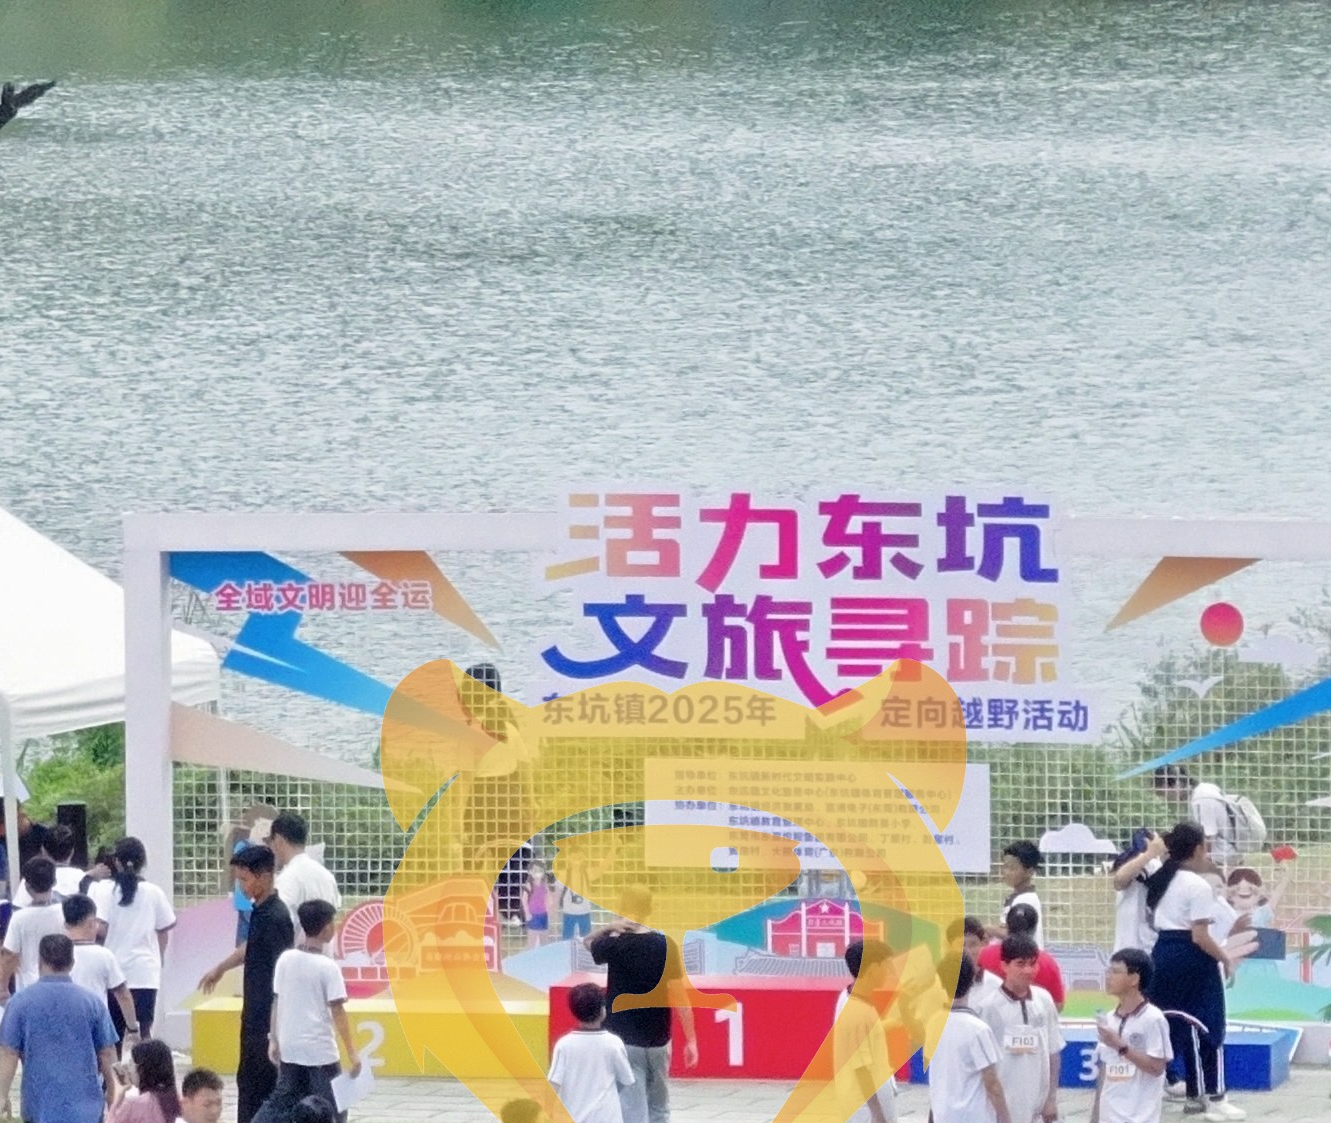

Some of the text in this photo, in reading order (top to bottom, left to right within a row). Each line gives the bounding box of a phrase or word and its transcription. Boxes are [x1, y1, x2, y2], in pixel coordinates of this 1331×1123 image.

[545, 492, 1059, 593] 活力东坑
[214, 581, 434, 614] 全域文明迎全运
[540, 594, 1059, 718] 文旅寻踪
[542, 691, 1089, 733] 东坑镇2025年 定向越野活动
[356, 1020, 386, 1067] 2
[714, 1009, 744, 1067] 1
[1078, 1046, 1099, 1082] 3
